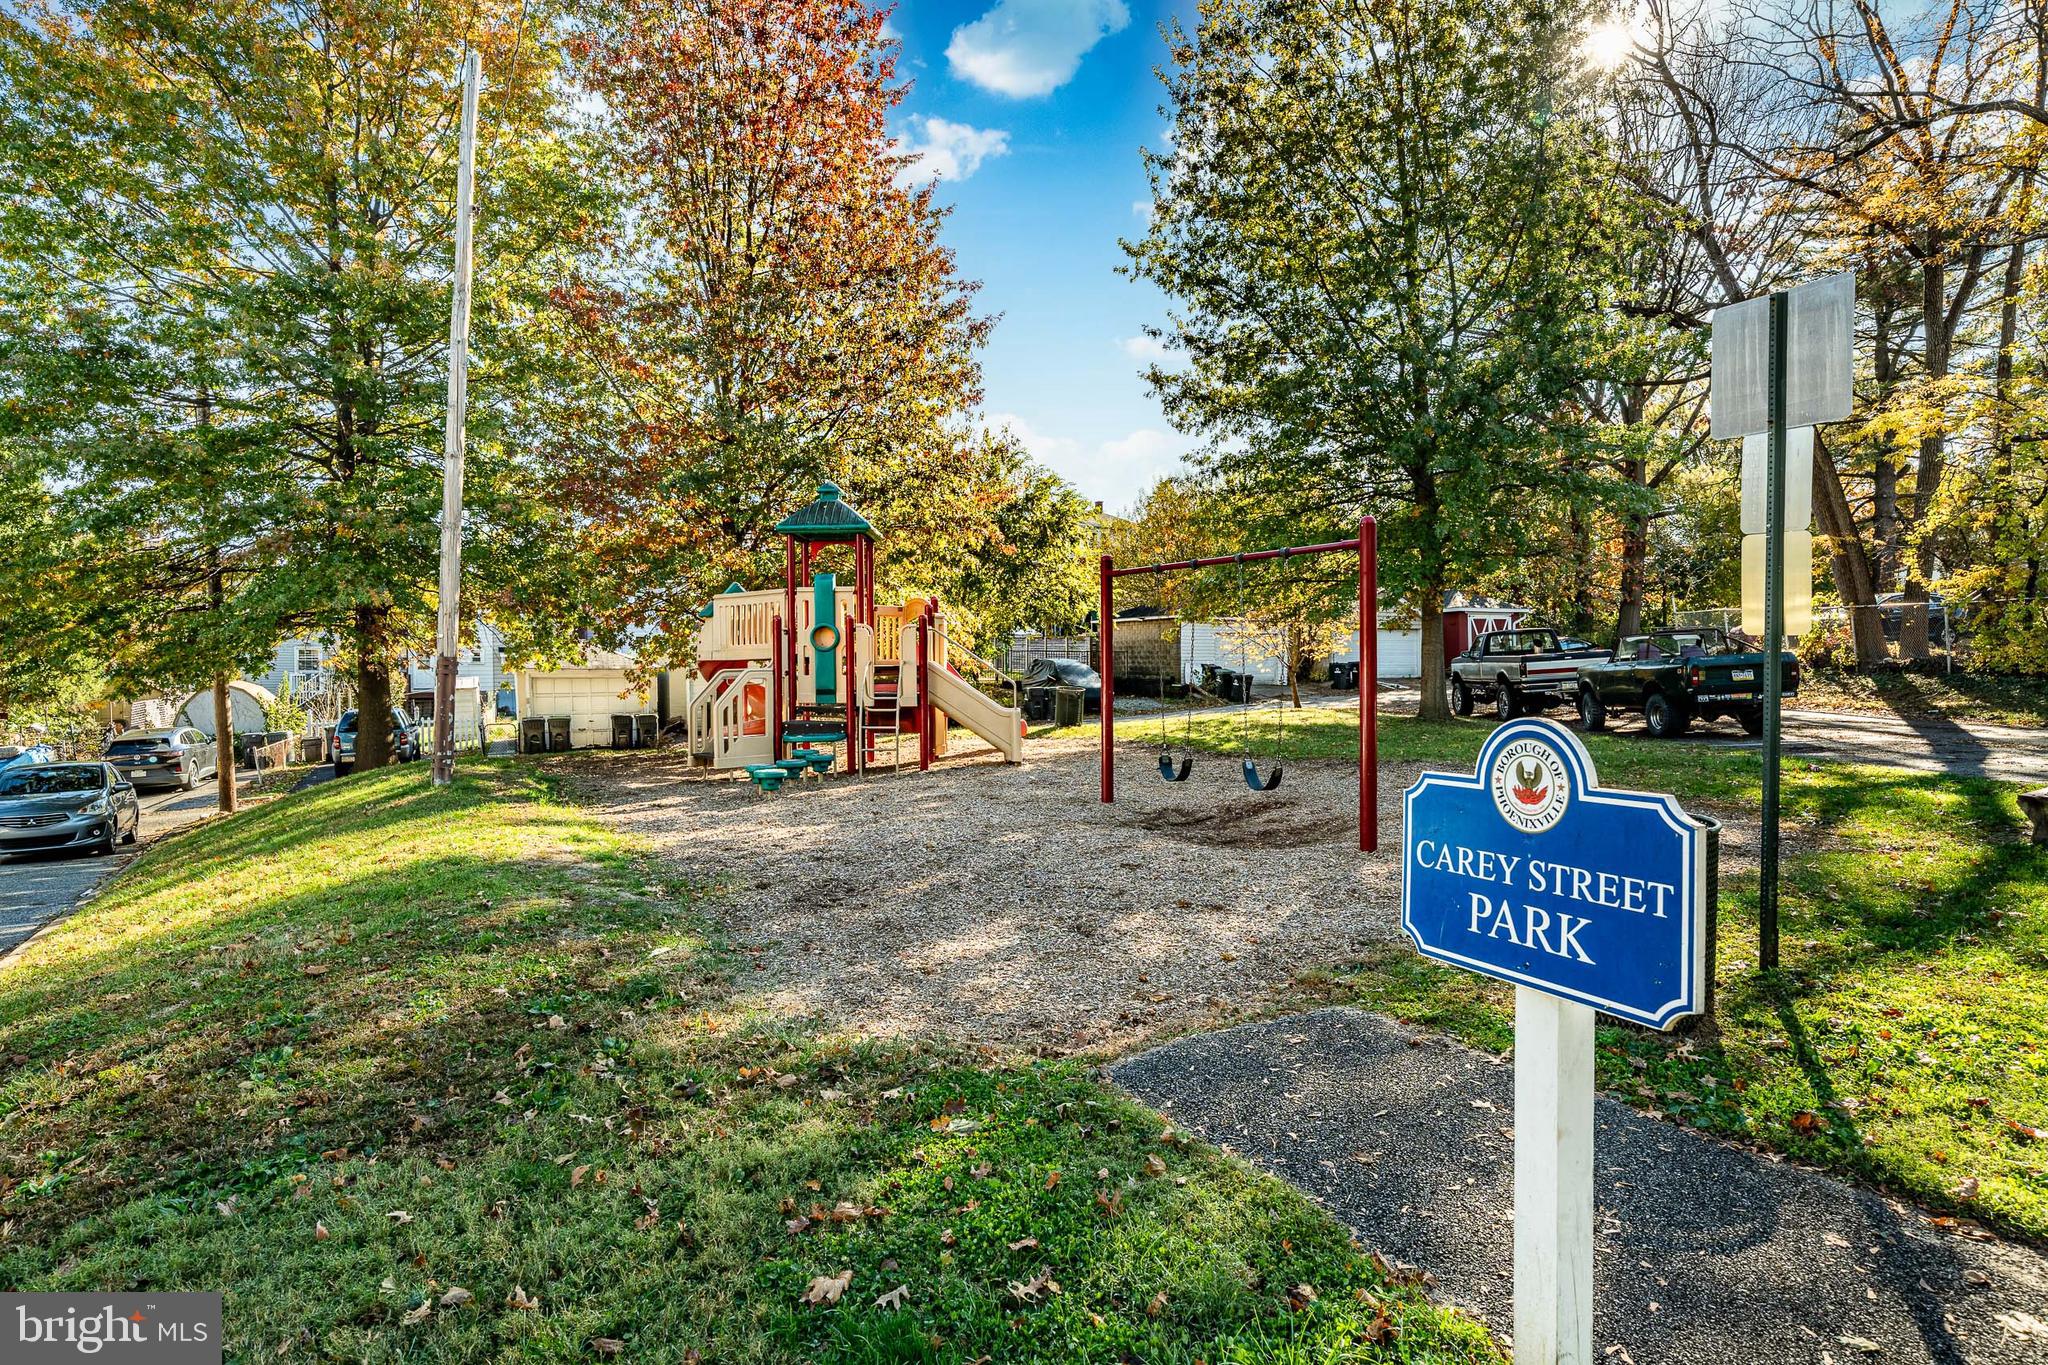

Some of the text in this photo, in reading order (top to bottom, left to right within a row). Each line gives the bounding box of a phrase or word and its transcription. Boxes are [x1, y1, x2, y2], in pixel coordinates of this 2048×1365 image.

[1497, 743, 1564, 780] BOROUGH OF
[1496, 786, 1565, 829] PHOENIXVILLE
[1416, 840, 1674, 918] CAREY STREET
[1467, 892, 1596, 965] PARK
